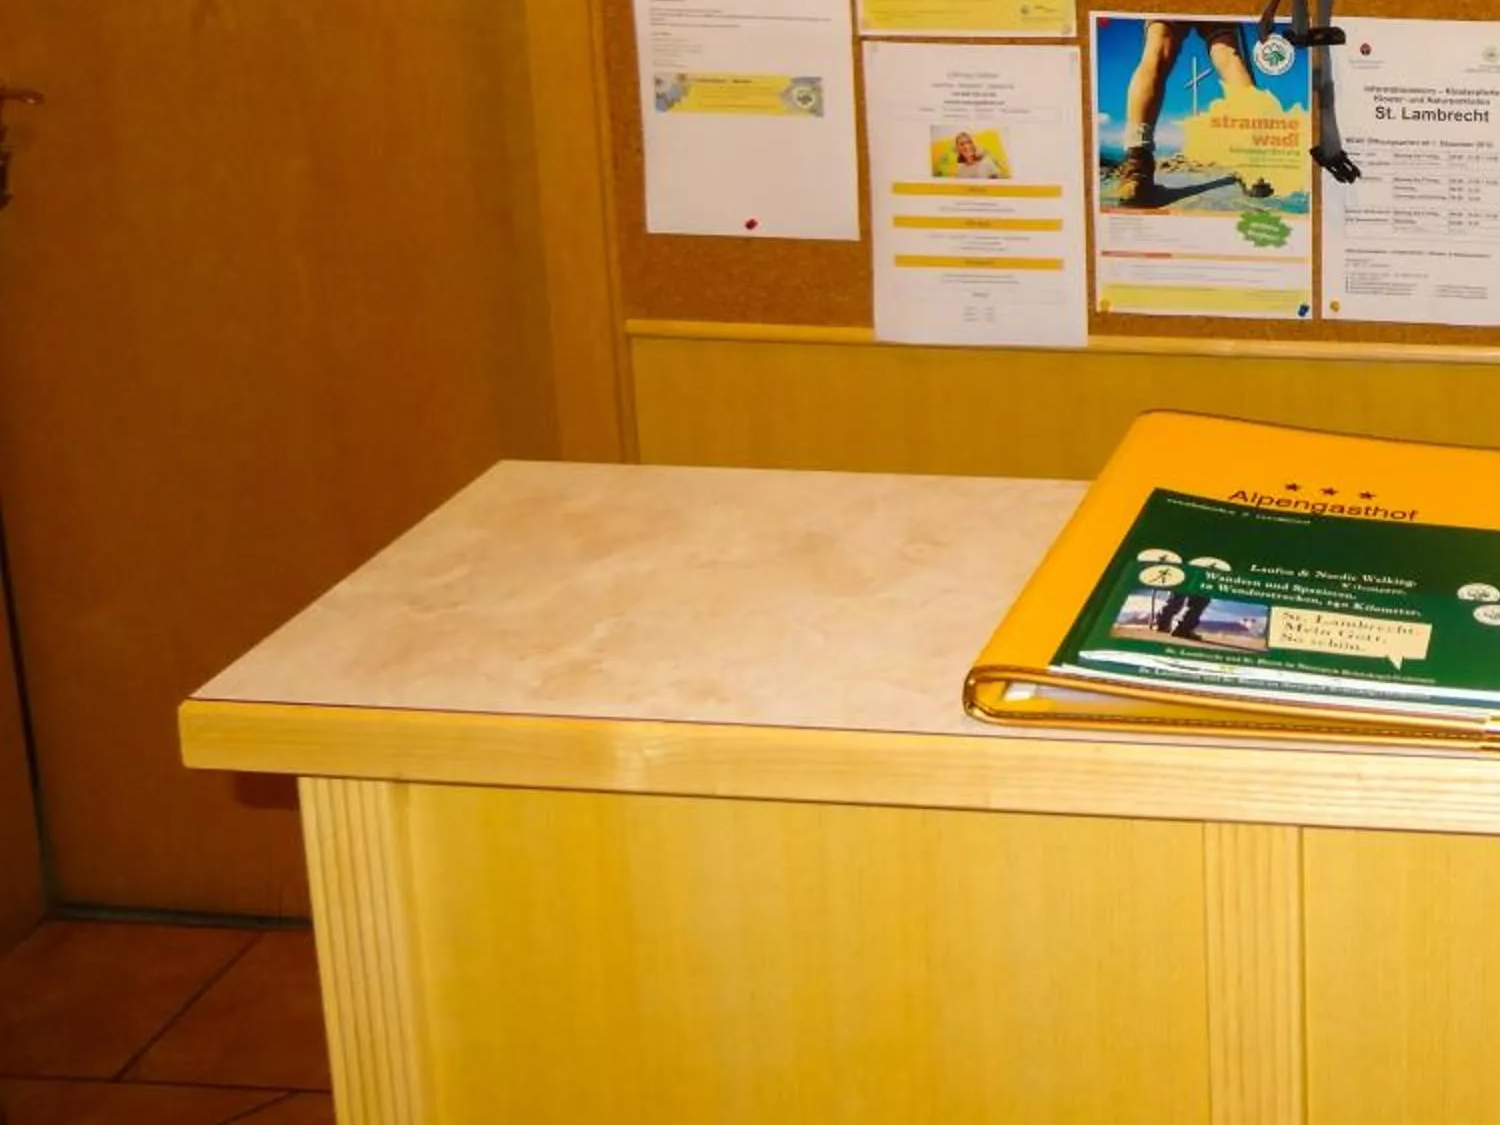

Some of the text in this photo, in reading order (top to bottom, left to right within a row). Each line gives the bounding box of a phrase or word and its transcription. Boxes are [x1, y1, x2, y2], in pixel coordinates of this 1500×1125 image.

[1210, 115, 1299, 130] stramme
[1375, 106, 1489, 123] St. Lambrecht
[1228, 490, 1418, 522] Alpengasthof
[1206, 572, 1261, 587] Wandern
[1265, 581, 1289, 591] und
[1297, 569, 1309, 578] &
